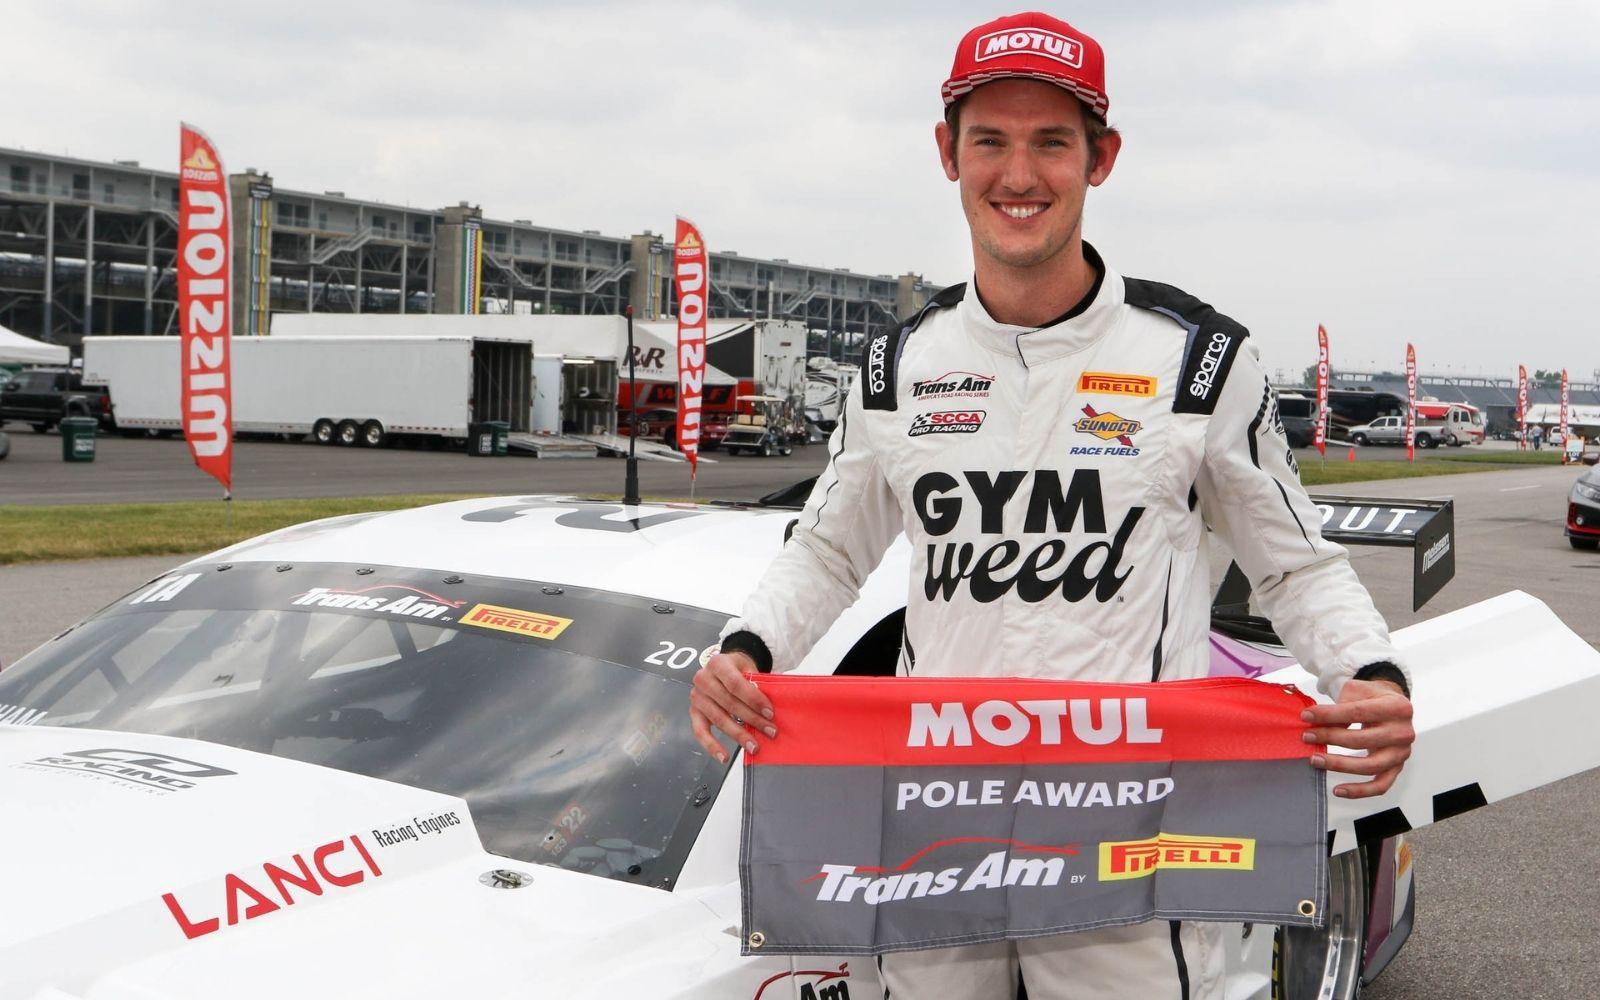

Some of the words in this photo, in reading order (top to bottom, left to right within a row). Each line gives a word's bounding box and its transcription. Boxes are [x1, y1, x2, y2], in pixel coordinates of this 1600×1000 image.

[984, 32, 1075, 60] MOTUL
[872, 335, 888, 393] sparco
[1190, 332, 1227, 398] sparco
[912, 381, 957, 397] Trans
[957, 377, 991, 391] Am
[1082, 375, 1150, 394] PIRELLI
[910, 425, 930, 435] PRO
[932, 424, 978, 432] RACING
[931, 412, 981, 423] SCCA
[1078, 419, 1139, 433] SUNOCO
[1070, 447, 1101, 455] RACE
[1104, 447, 1140, 456] FUELS
[913, 469, 1107, 536] GYM
[924, 507, 1146, 603] weed
[292, 588, 387, 610] Trans
[376, 595, 449, 619] Am
[471, 609, 559, 634] PIRELLI
[906, 698, 1163, 747] MOTUL
[34, 757, 197, 788] RACING
[896, 780, 1005, 811] POLE
[1012, 777, 1175, 808] AWARD
[372, 824, 418, 848] Racing
[415, 810, 460, 836] Engines
[1111, 839, 1243, 873] PIRELLI
[162, 835, 383, 939] LANCI
[816, 864, 963, 905] Trans
[960, 851, 1065, 891] Am
[1070, 875, 1087, 884] BY
